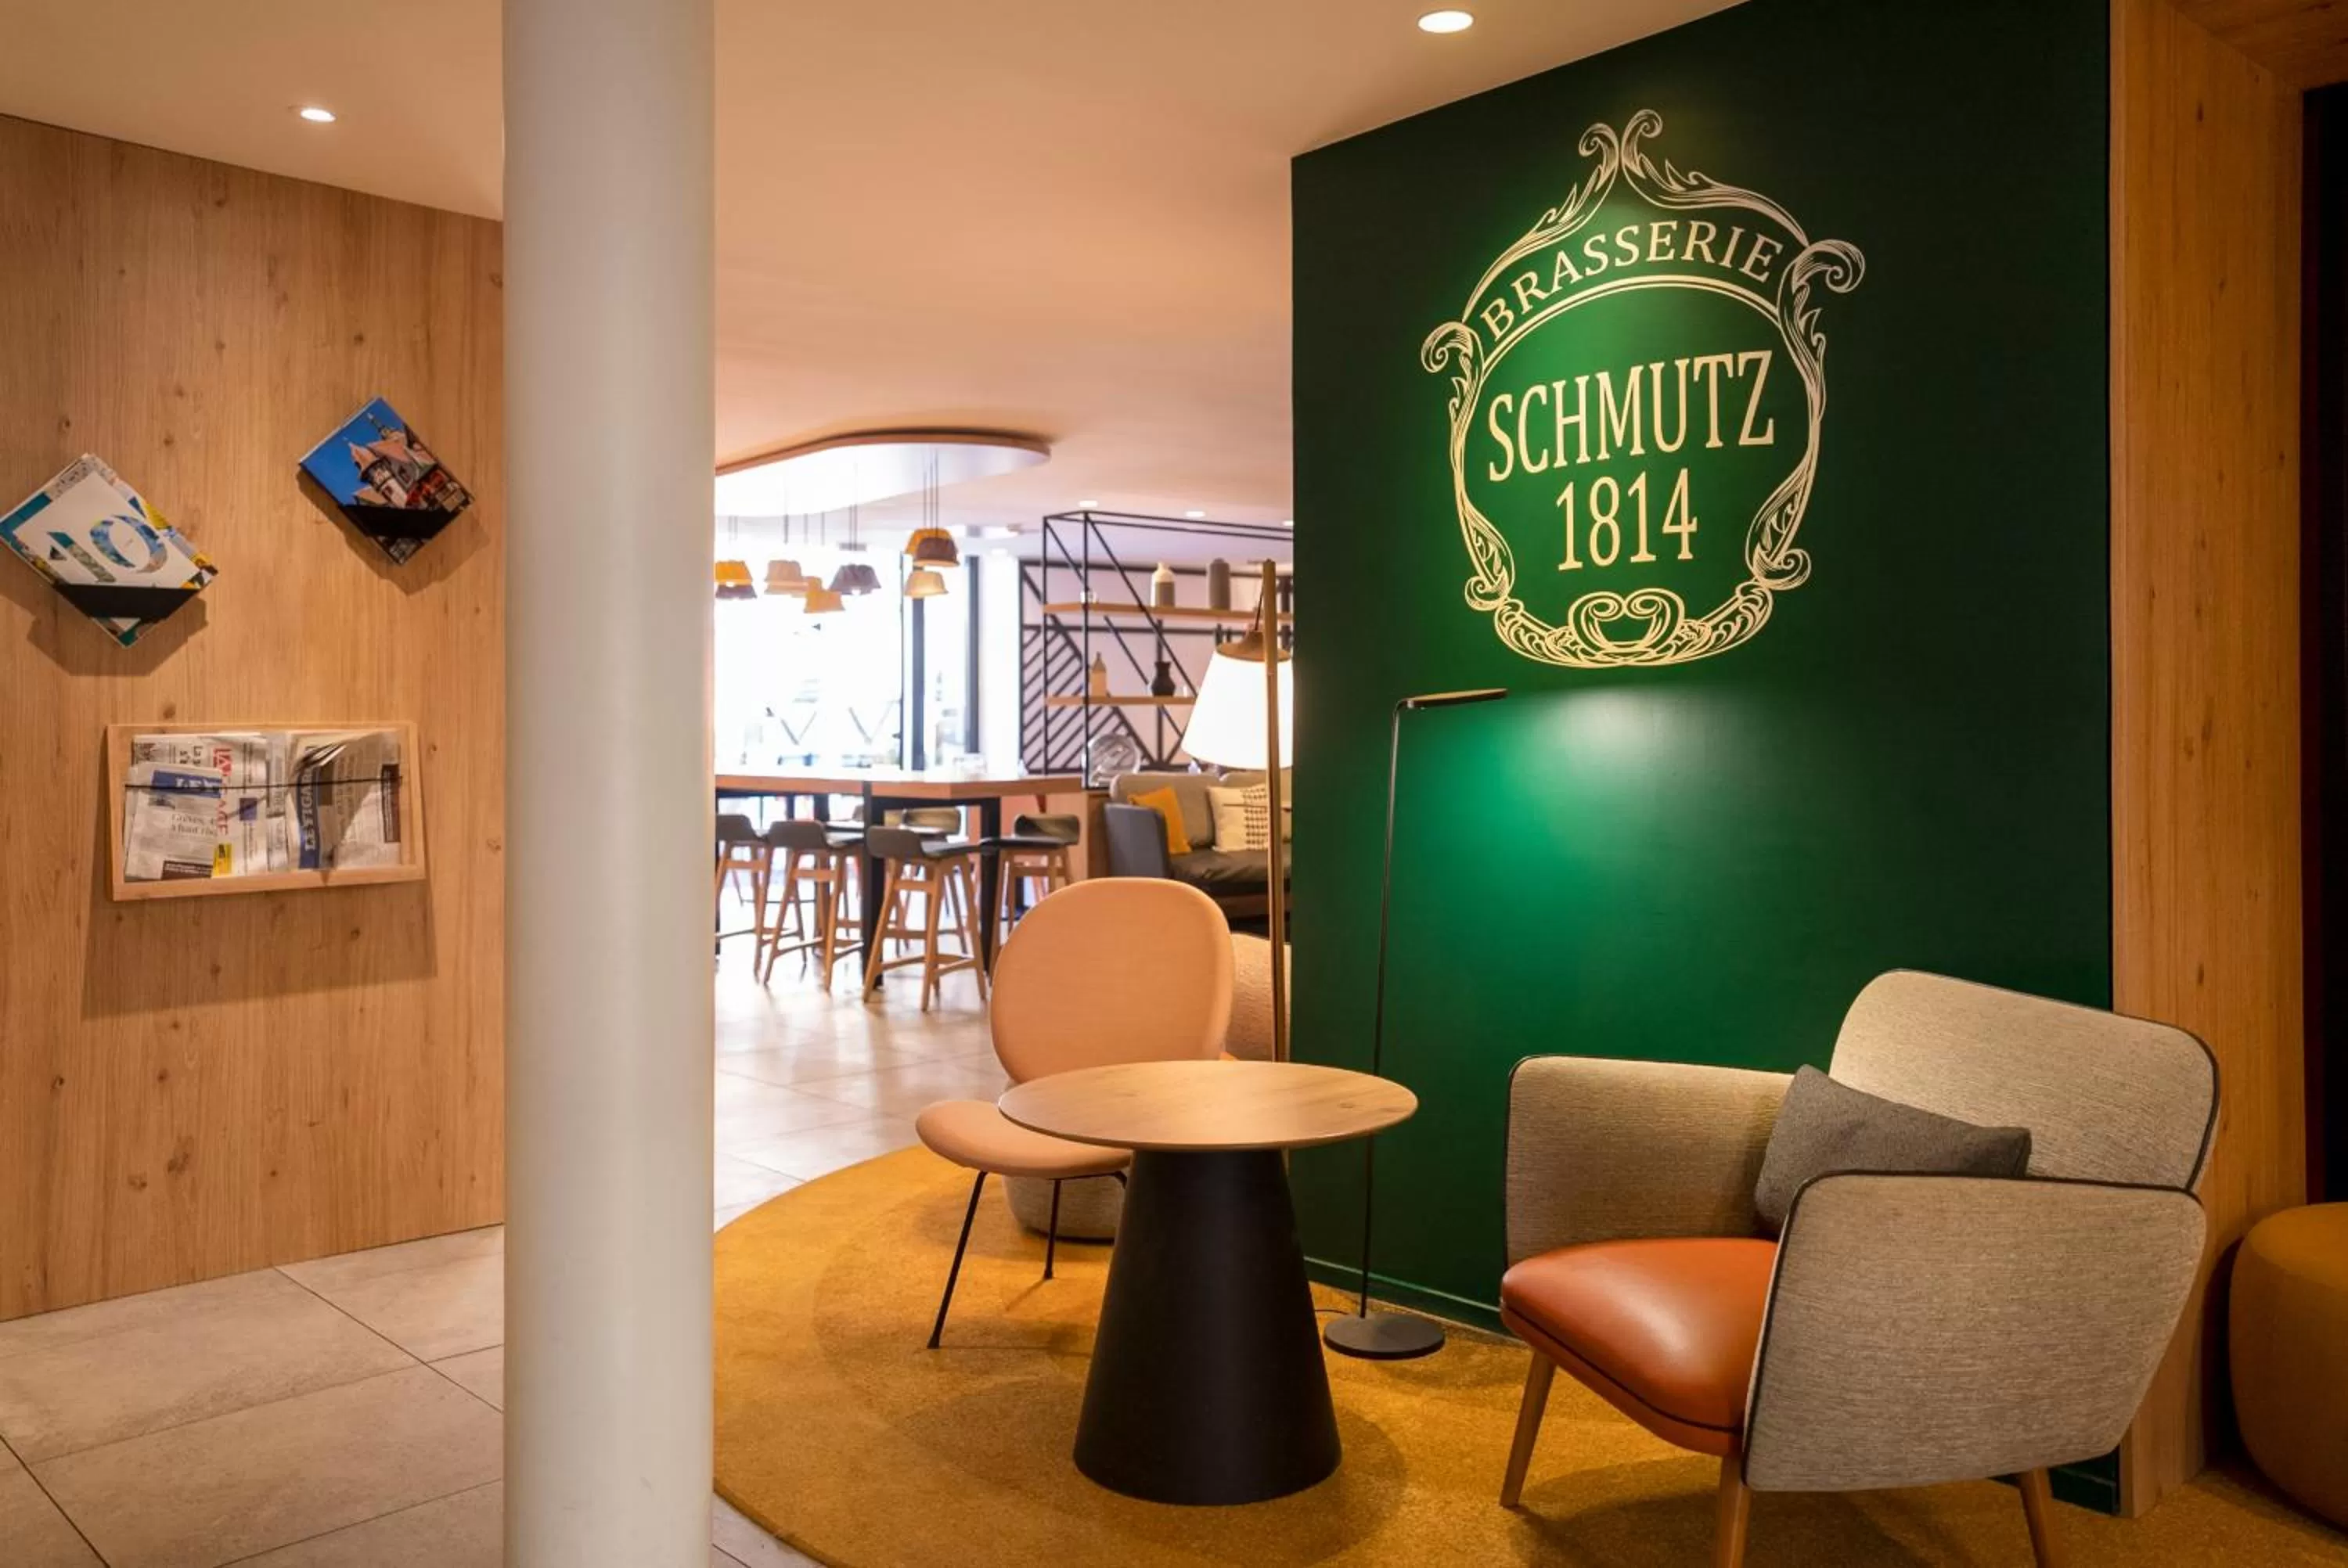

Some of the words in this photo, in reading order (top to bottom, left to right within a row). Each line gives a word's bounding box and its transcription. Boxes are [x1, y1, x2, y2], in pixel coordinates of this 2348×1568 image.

[1479, 219, 1784, 342] BRASSERIE
[1488, 349, 1775, 484] SCHMUTZ
[1554, 467, 1698, 572] 1814
[300, 765, 315, 827] FIGAR
